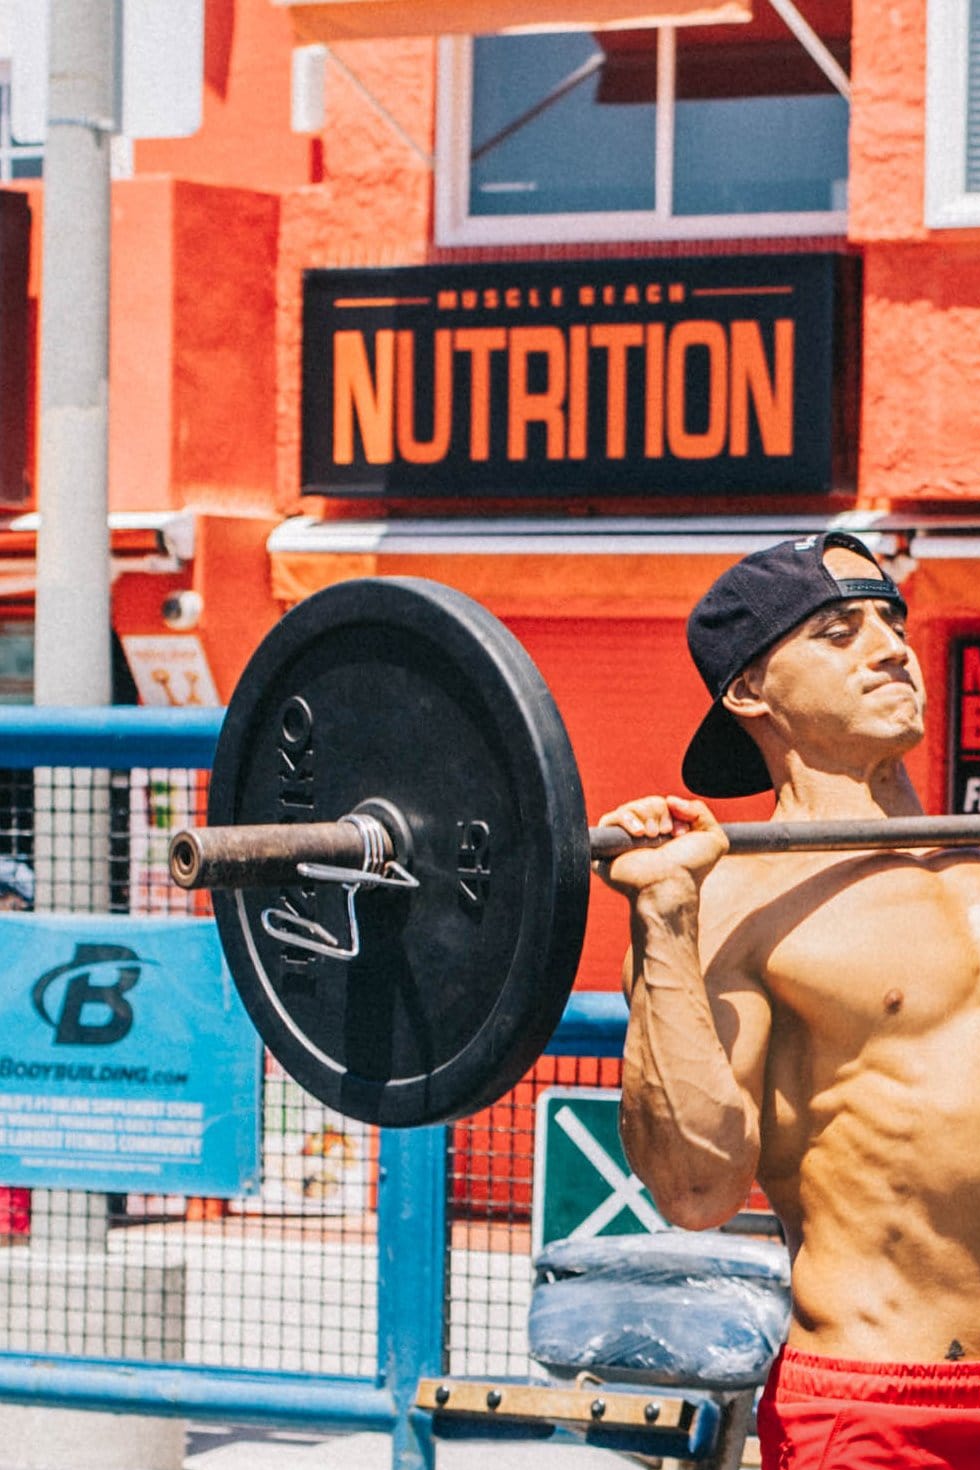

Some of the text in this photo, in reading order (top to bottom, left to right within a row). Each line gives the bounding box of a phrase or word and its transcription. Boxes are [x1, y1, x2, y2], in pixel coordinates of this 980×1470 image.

[437, 282, 685, 310] MUSCLE BEACH
[333, 318, 795, 465] NUTRITION
